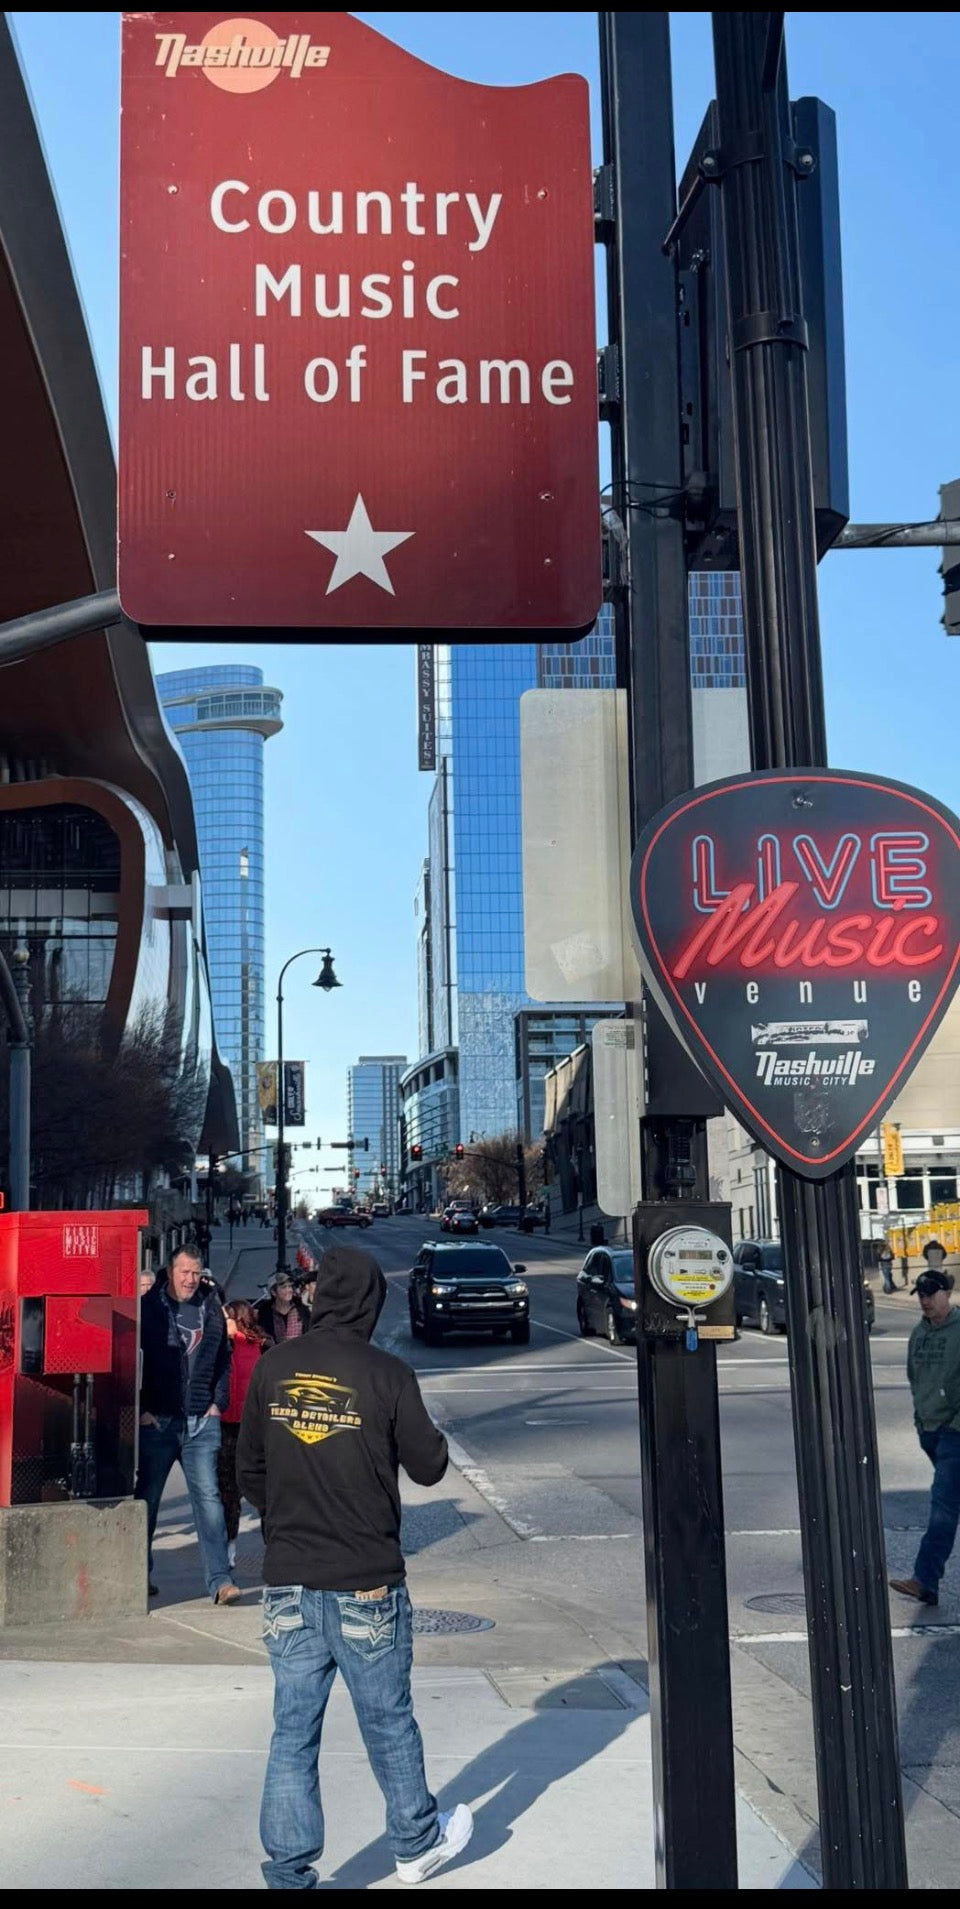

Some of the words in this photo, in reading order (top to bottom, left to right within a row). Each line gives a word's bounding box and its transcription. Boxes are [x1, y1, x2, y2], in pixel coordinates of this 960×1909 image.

[155, 34, 331, 78] Nashville
[210, 180, 502, 251] Country
[255, 260, 460, 319] Music
[141, 343, 270, 401] Hall
[304, 345, 366, 402] of
[402, 350, 574, 404] Fame
[422, 704, 432, 759] SUITES
[692, 832, 932, 912] LIVE
[673, 881, 943, 979] Music
[695, 980, 921, 1004] venue
[755, 1051, 875, 1085] Nashville
[774, 1077, 810, 1086] MUSIC
[823, 1076, 848, 1086] CITY
[66, 1227, 96, 1236] VISIT
[66, 1235, 96, 1245] MUSIC
